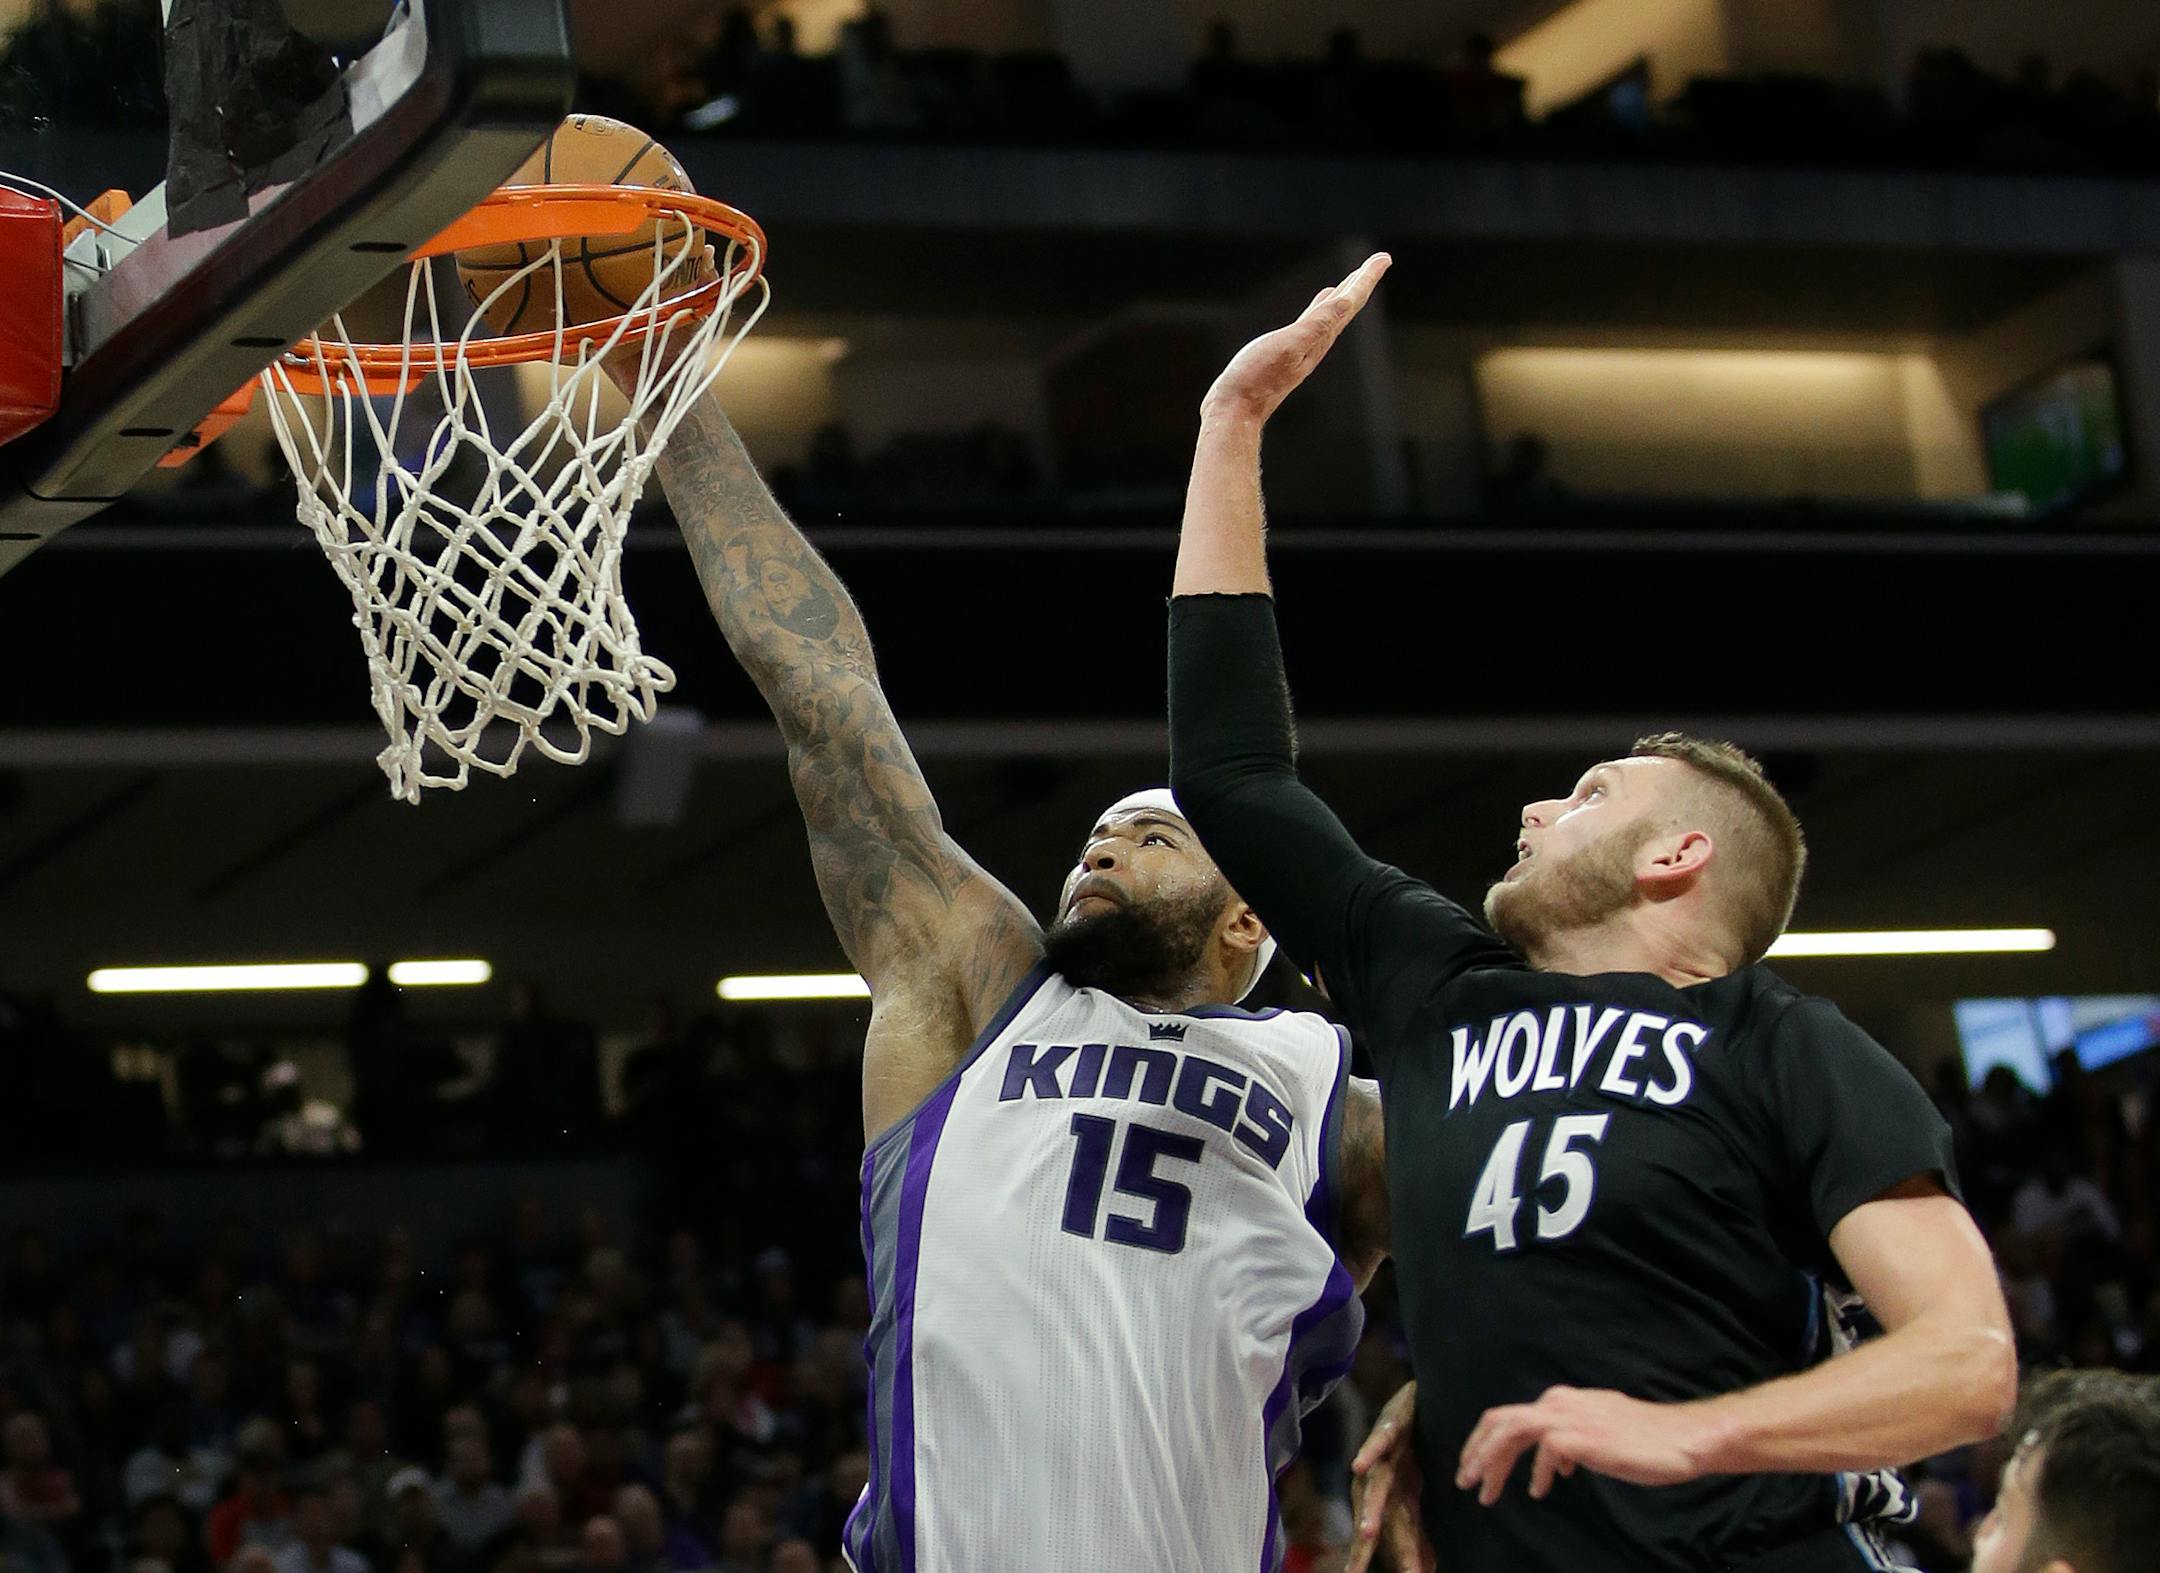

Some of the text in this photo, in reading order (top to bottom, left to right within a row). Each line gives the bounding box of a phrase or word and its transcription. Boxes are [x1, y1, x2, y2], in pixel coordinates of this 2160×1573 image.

[999, 1043, 1295, 1172] KINGS
[1447, 1004, 1710, 1112] WOLVES
[1060, 1111, 1206, 1255] 15
[1463, 1112, 1611, 1251] 45
